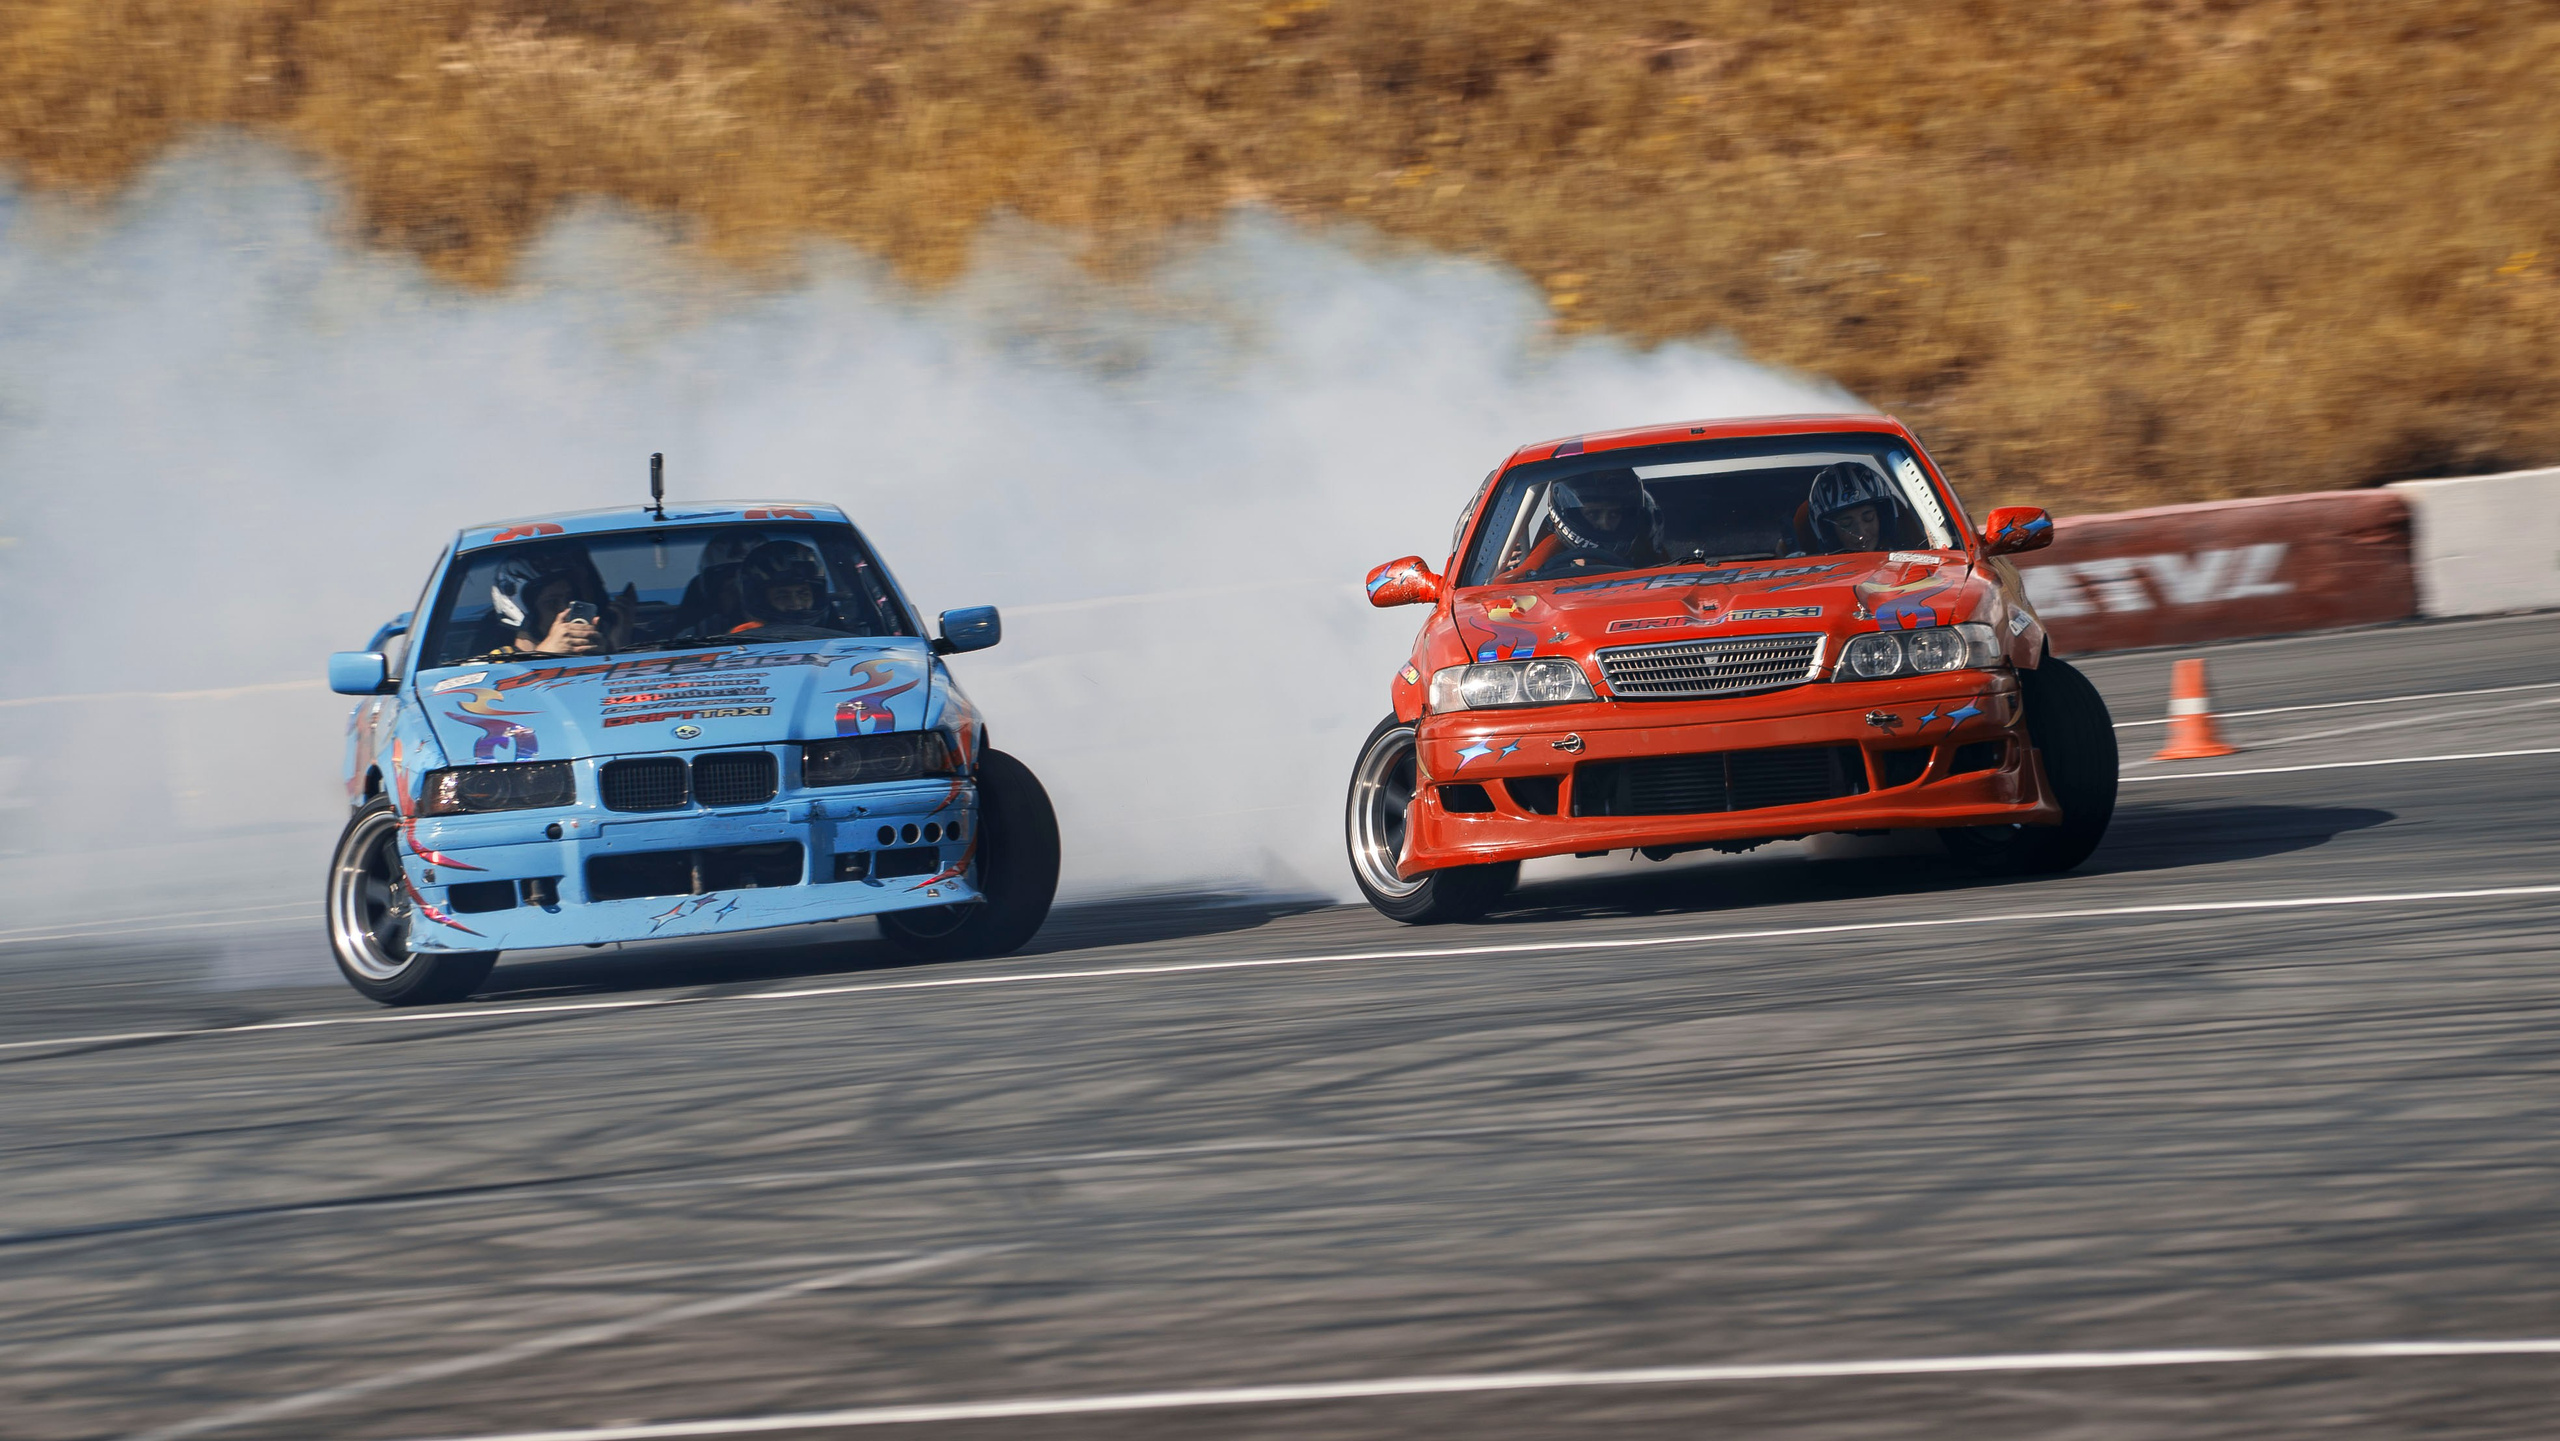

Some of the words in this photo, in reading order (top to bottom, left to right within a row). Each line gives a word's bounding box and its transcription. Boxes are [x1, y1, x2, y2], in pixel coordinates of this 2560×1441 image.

[1643, 560, 1853, 590] READY
[495, 651, 732, 691] DRIFT
[602, 653, 848, 682] READY
